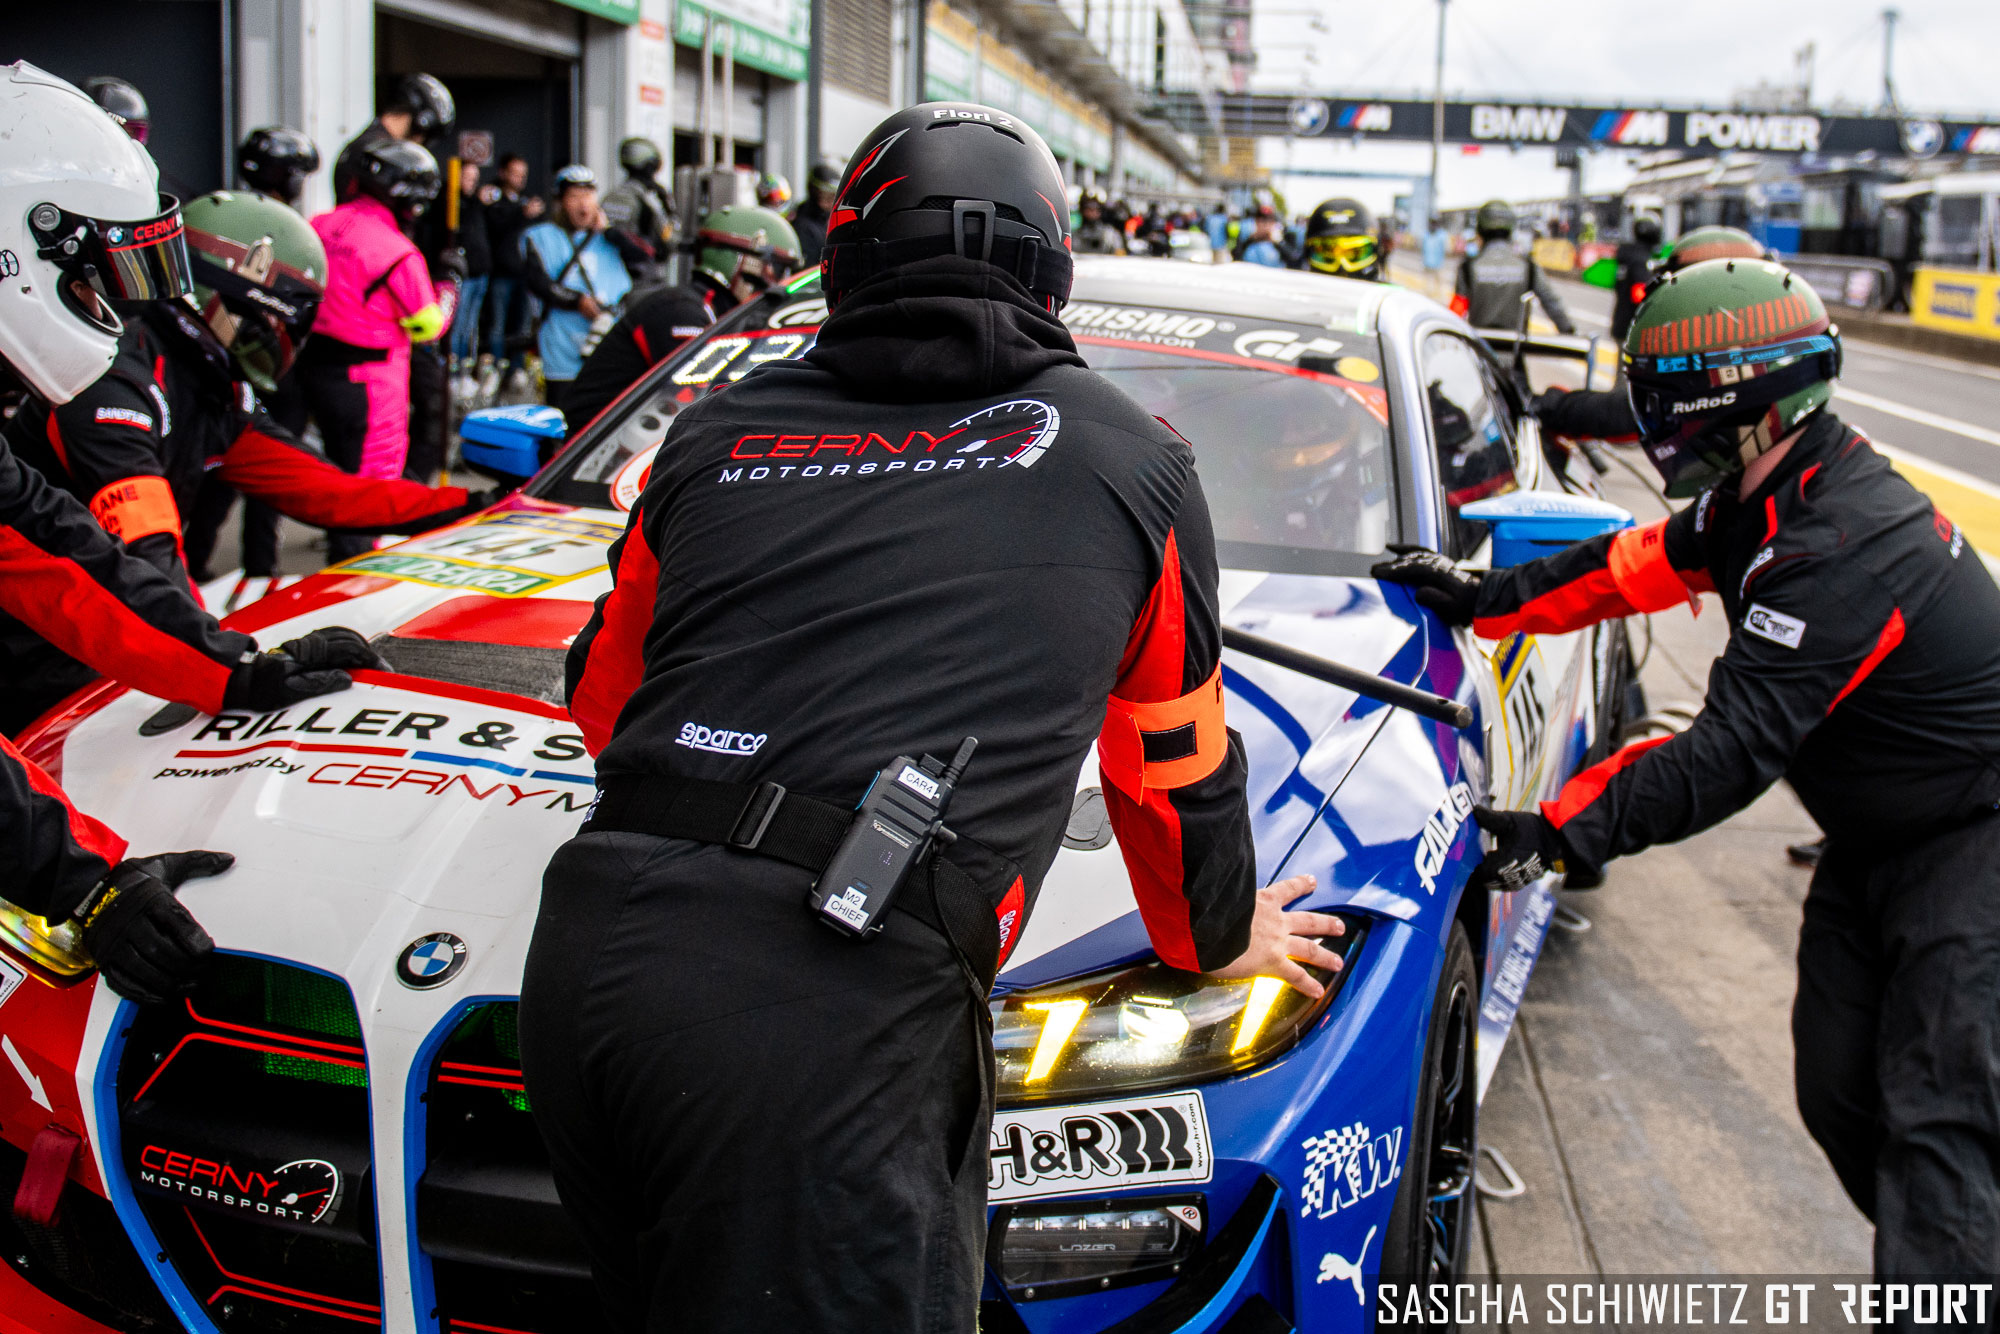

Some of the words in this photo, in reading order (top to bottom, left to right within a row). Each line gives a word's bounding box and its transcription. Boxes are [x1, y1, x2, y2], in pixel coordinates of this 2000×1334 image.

[998, 117, 1014, 128] 2
[1470, 104, 1567, 142] BMW
[1684, 112, 1821, 152] POWER
[133, 215, 176, 241] CERNY
[730, 426, 969, 461] CERNY
[717, 456, 996, 484] MOTORSPORT
[400, 559, 542, 594] DEKRA
[192, 706, 450, 742] RILLER
[458, 721, 522, 752] &
[675, 721, 768, 756] sparco
[153, 756, 271, 780] powered
[264, 756, 306, 774] by
[306, 763, 558, 806] CERNY
[905, 772, 935, 794] CAR4
[1414, 781, 1477, 897] FALKEN
[830, 900, 864, 922] CHIEF
[844, 891, 861, 905] M2
[140, 1144, 279, 1199] CERNY
[140, 1170, 304, 1221] MOTORSPORT
